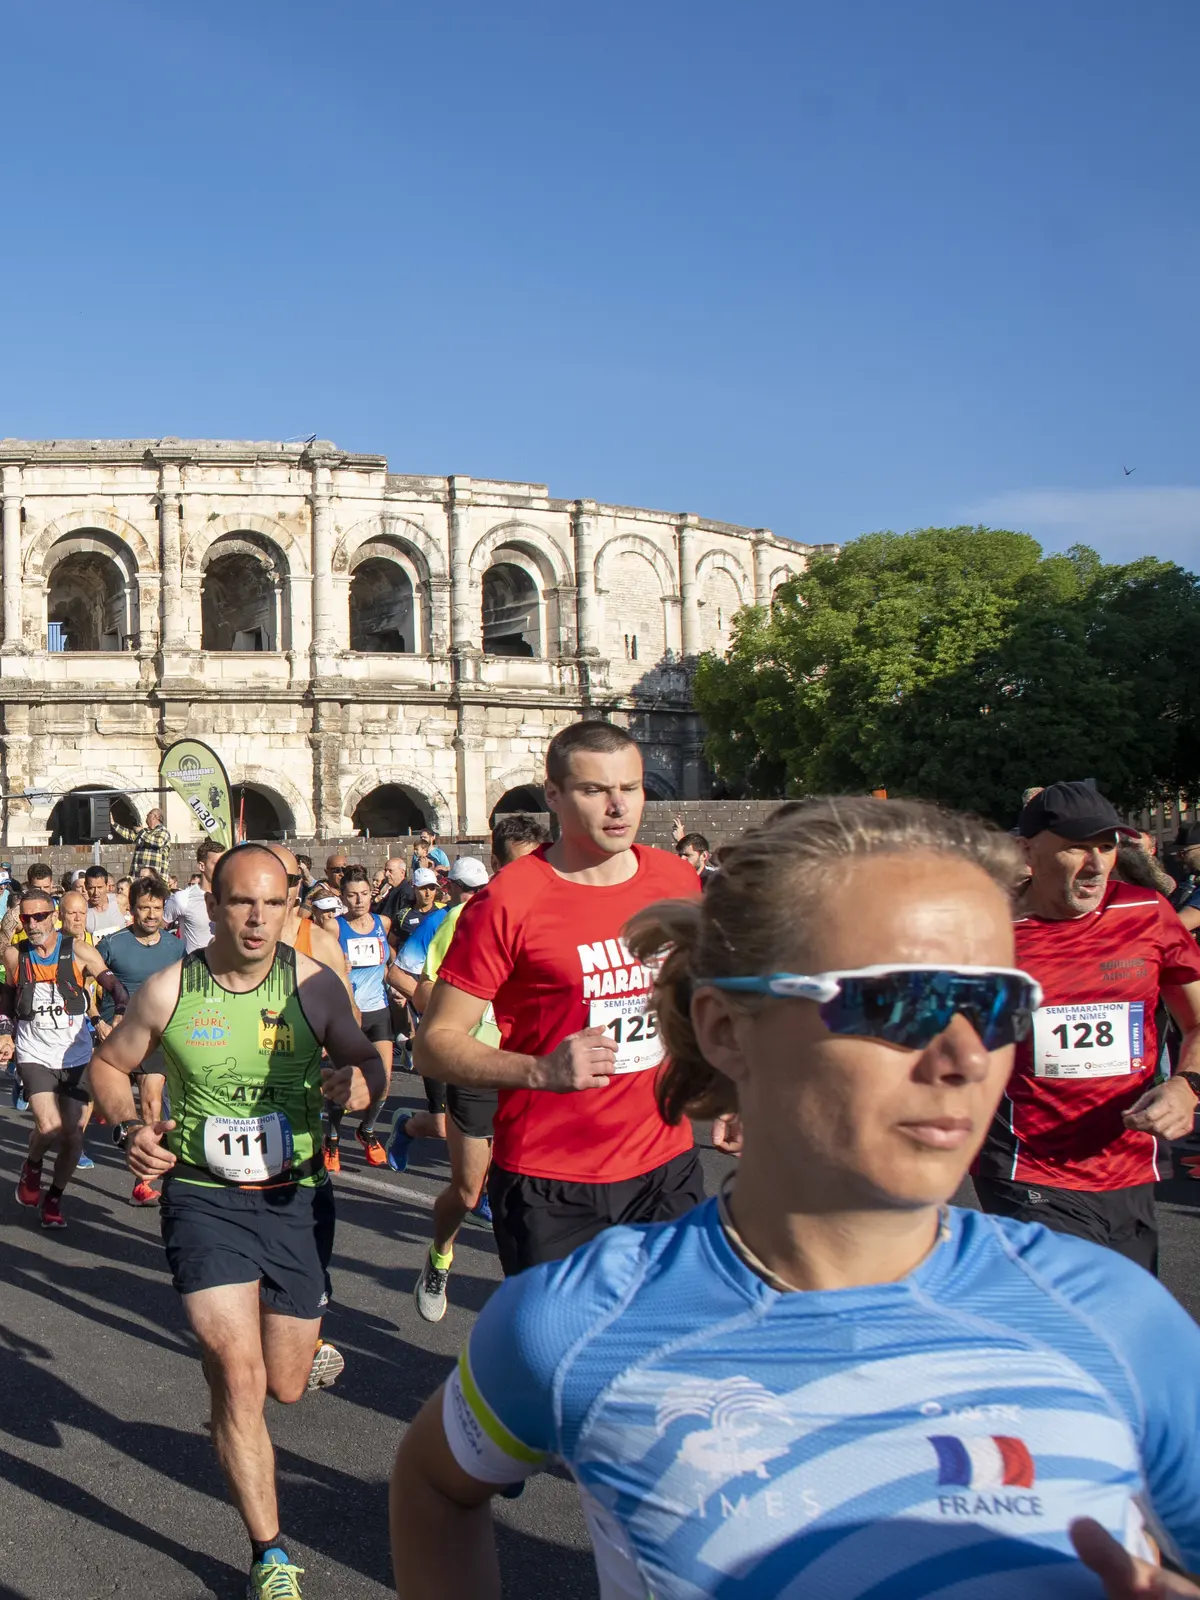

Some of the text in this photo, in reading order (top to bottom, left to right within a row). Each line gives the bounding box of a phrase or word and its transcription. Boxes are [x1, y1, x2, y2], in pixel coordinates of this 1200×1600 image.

[354, 944, 374, 955] 171
[583, 965, 654, 998] MARAT
[604, 998, 646, 1008] SEMI-MAR
[1046, 1003, 1124, 1015] SEMI-MARATHON
[194, 1017, 223, 1028] EURL
[607, 1013, 658, 1044] 125
[191, 1027, 225, 1040] MD
[1051, 1020, 1114, 1050] 128
[185, 1039, 227, 1047] PEINTURE
[262, 1035, 291, 1053] eni
[214, 1114, 276, 1126] SEMI-MARATHON
[217, 1132, 268, 1156] 111
[695, 1480, 826, 1519] ÎMES
[937, 1494, 1044, 1517] FRANCE
